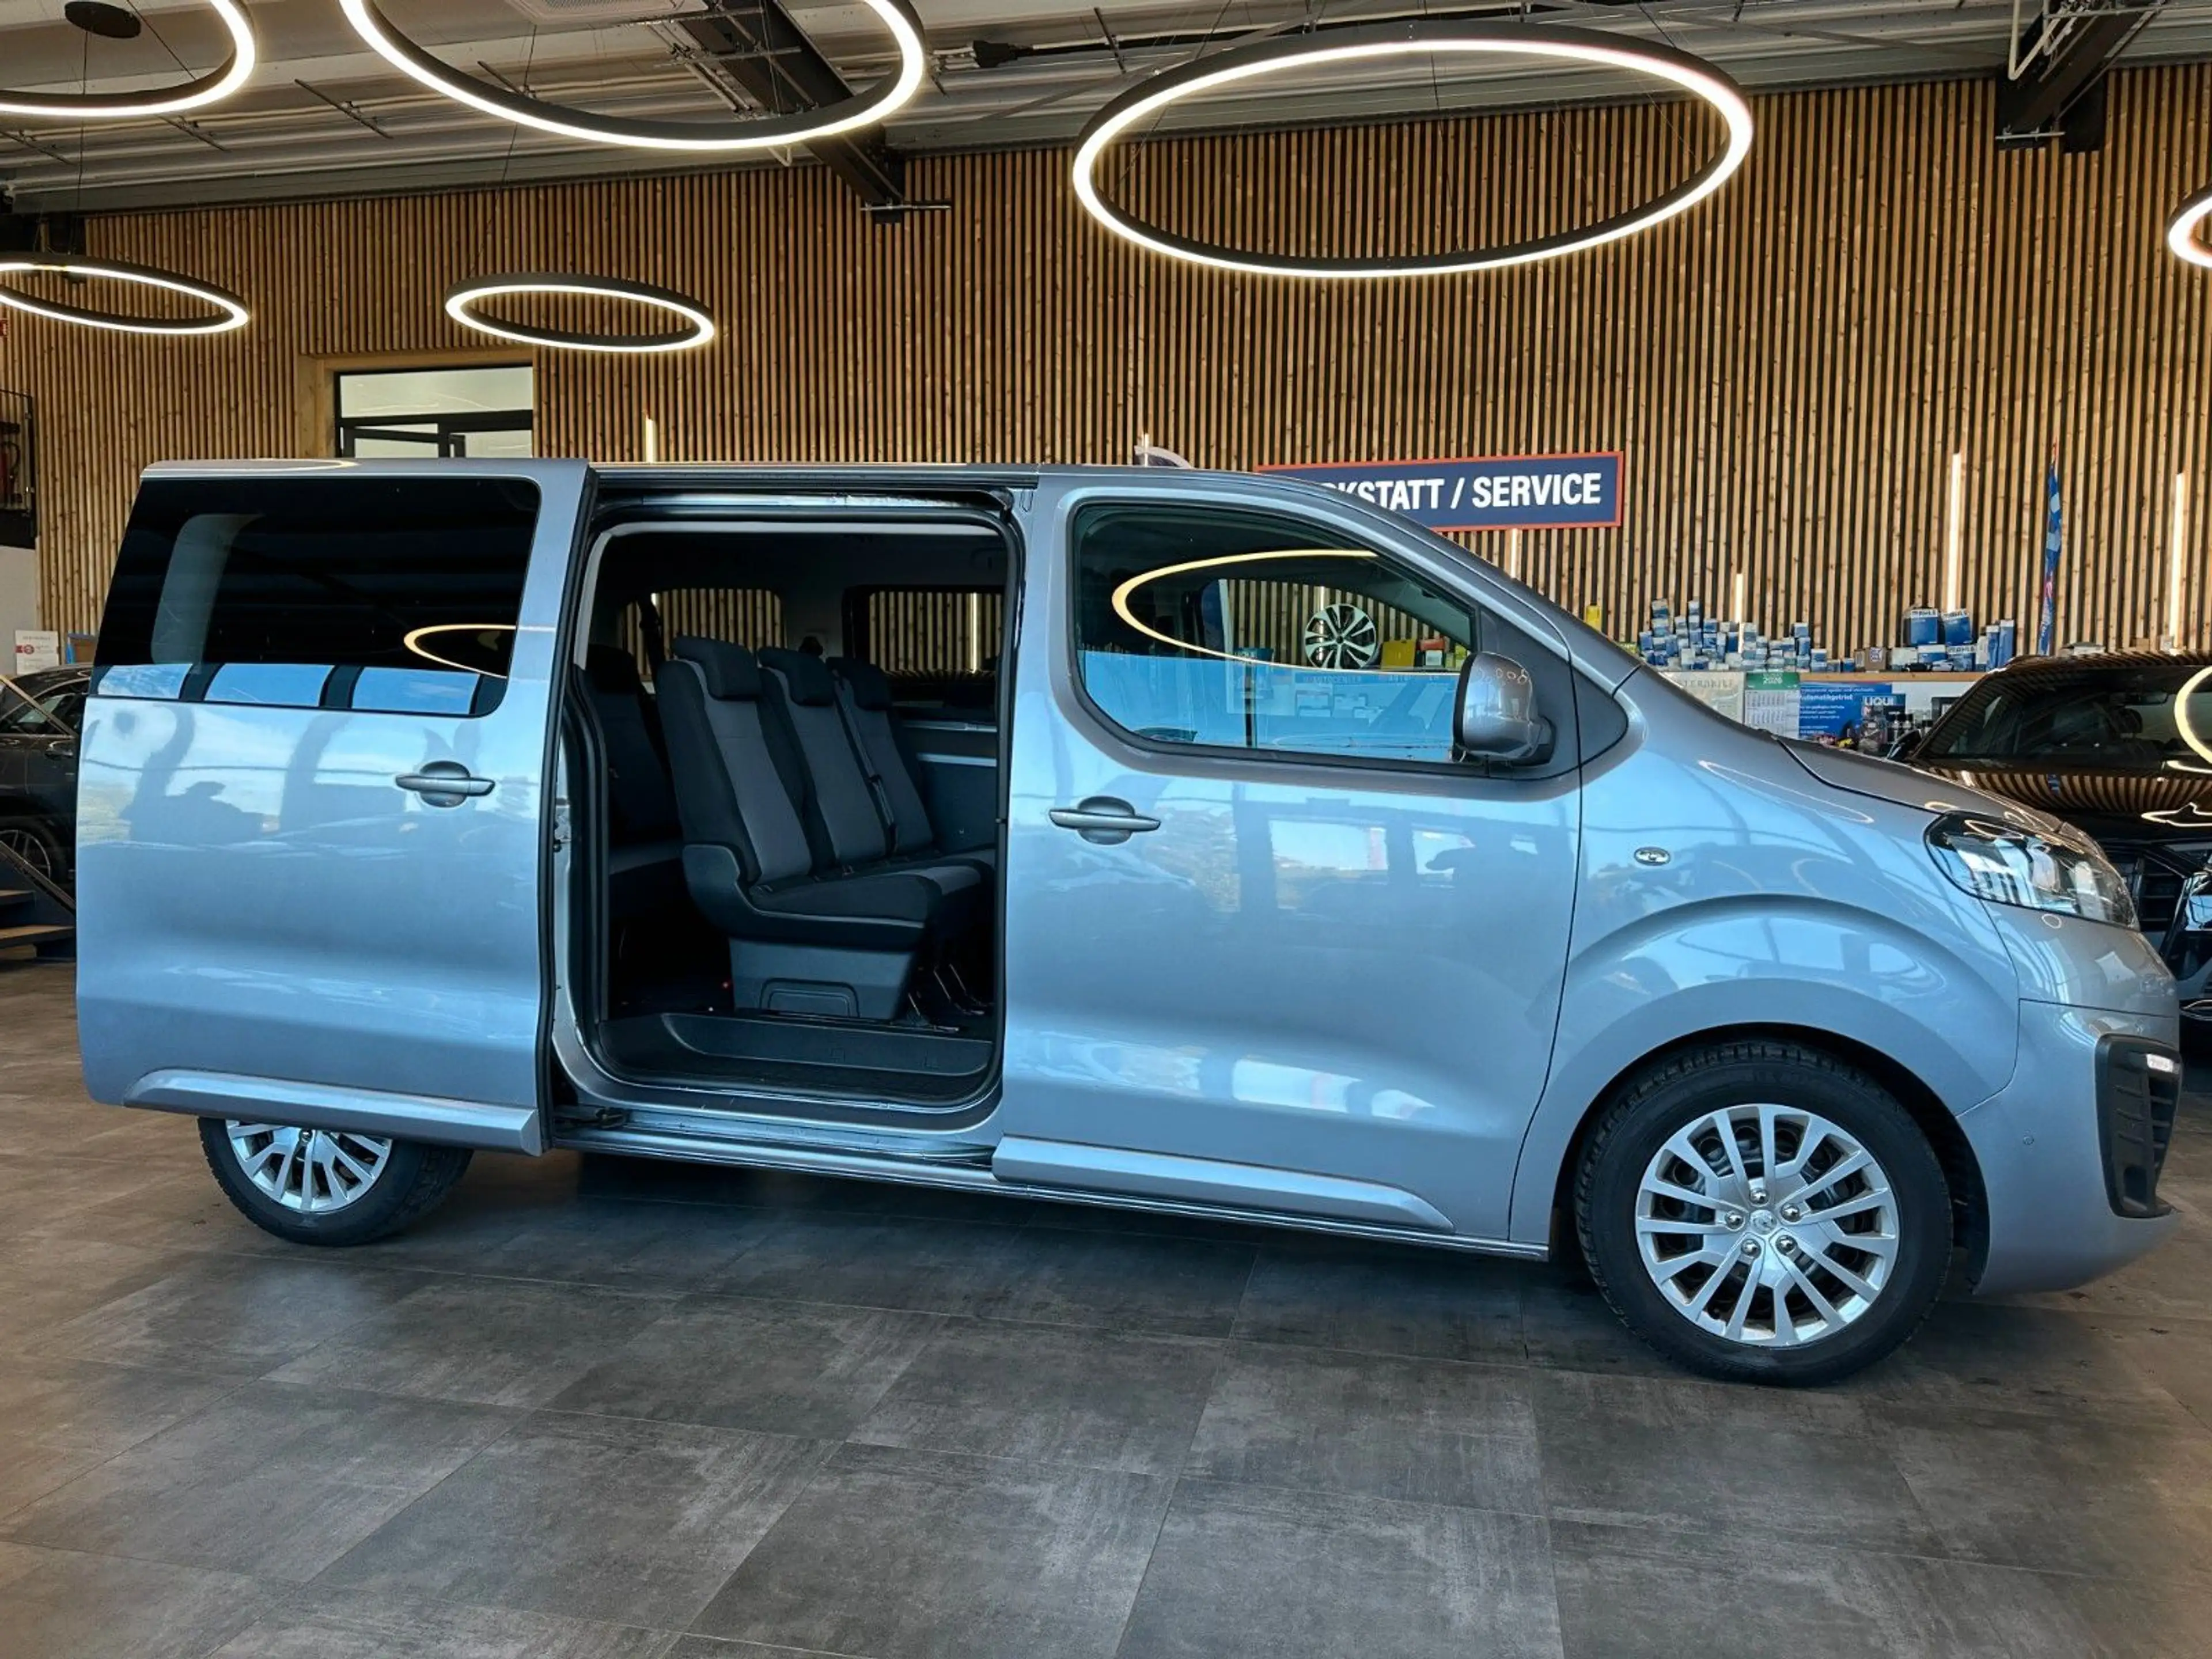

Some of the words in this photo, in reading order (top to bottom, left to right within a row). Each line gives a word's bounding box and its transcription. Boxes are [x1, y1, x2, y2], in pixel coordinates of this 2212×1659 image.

[1450, 478, 1464, 510] /
[1472, 472, 1601, 508] SERVICE
[1864, 697, 1894, 706] LIQUI
